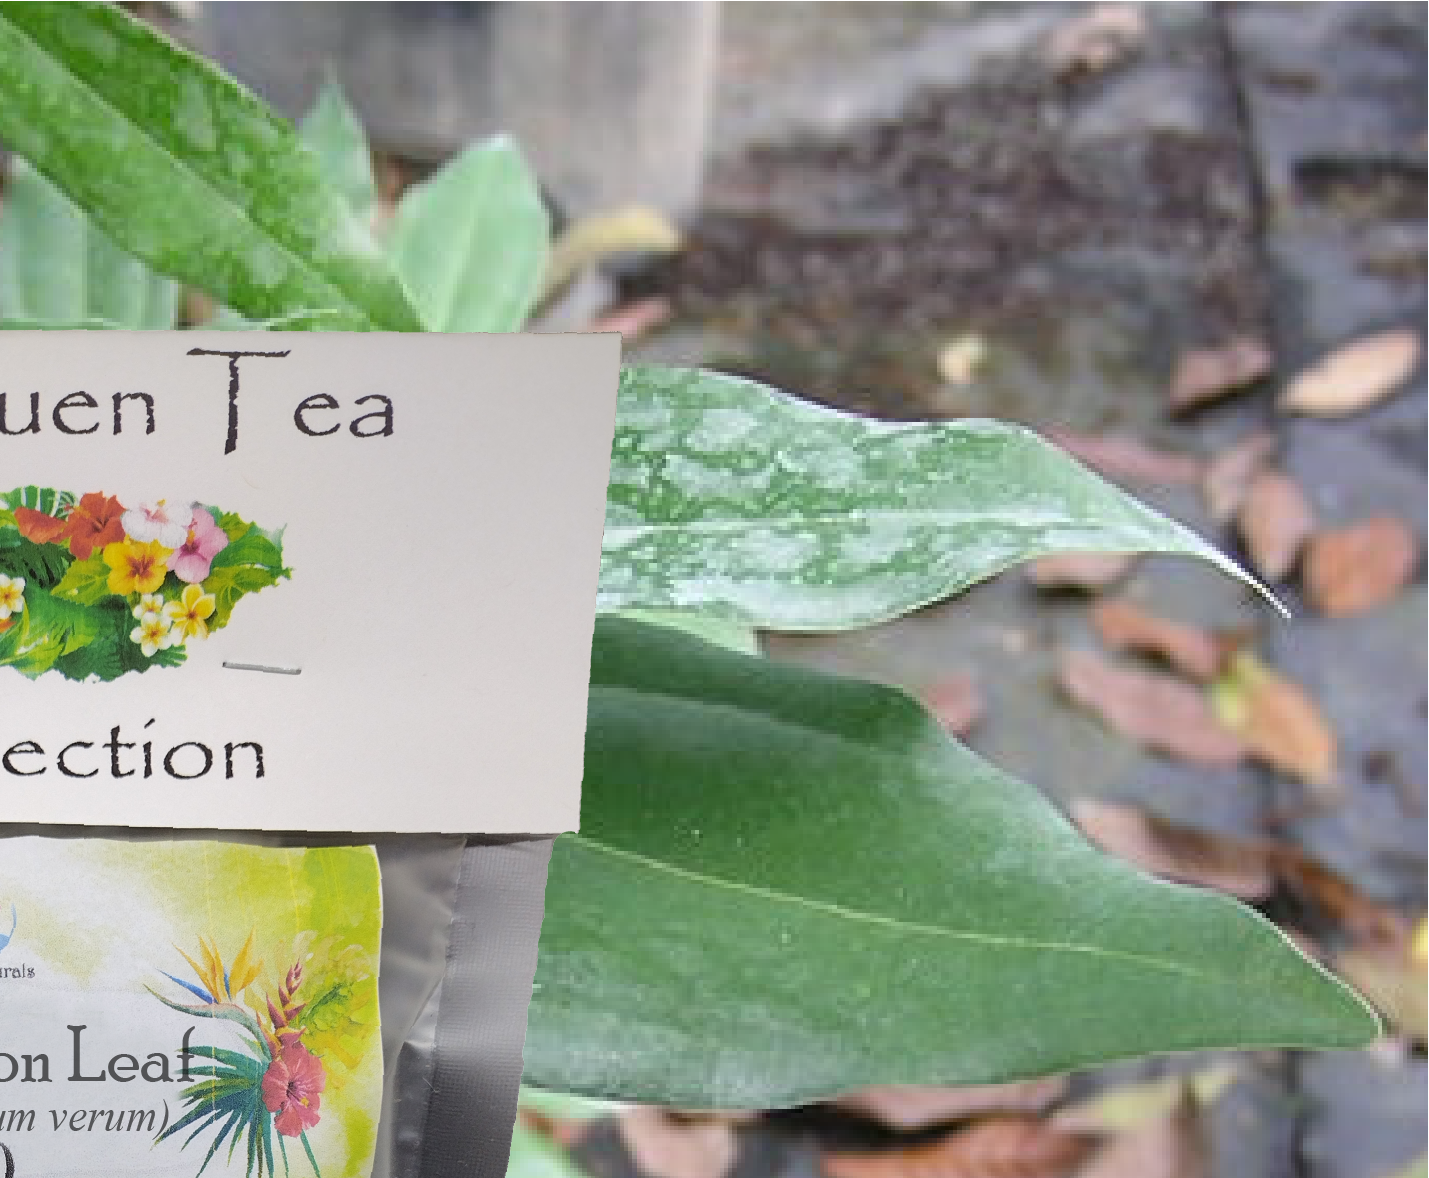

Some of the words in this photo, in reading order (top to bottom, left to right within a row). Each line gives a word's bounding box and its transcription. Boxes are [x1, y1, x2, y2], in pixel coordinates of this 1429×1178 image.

[186, 347, 396, 456] Tea
[66, 1023, 198, 1084] Leaf
[46, 1098, 171, 1140] verum)
